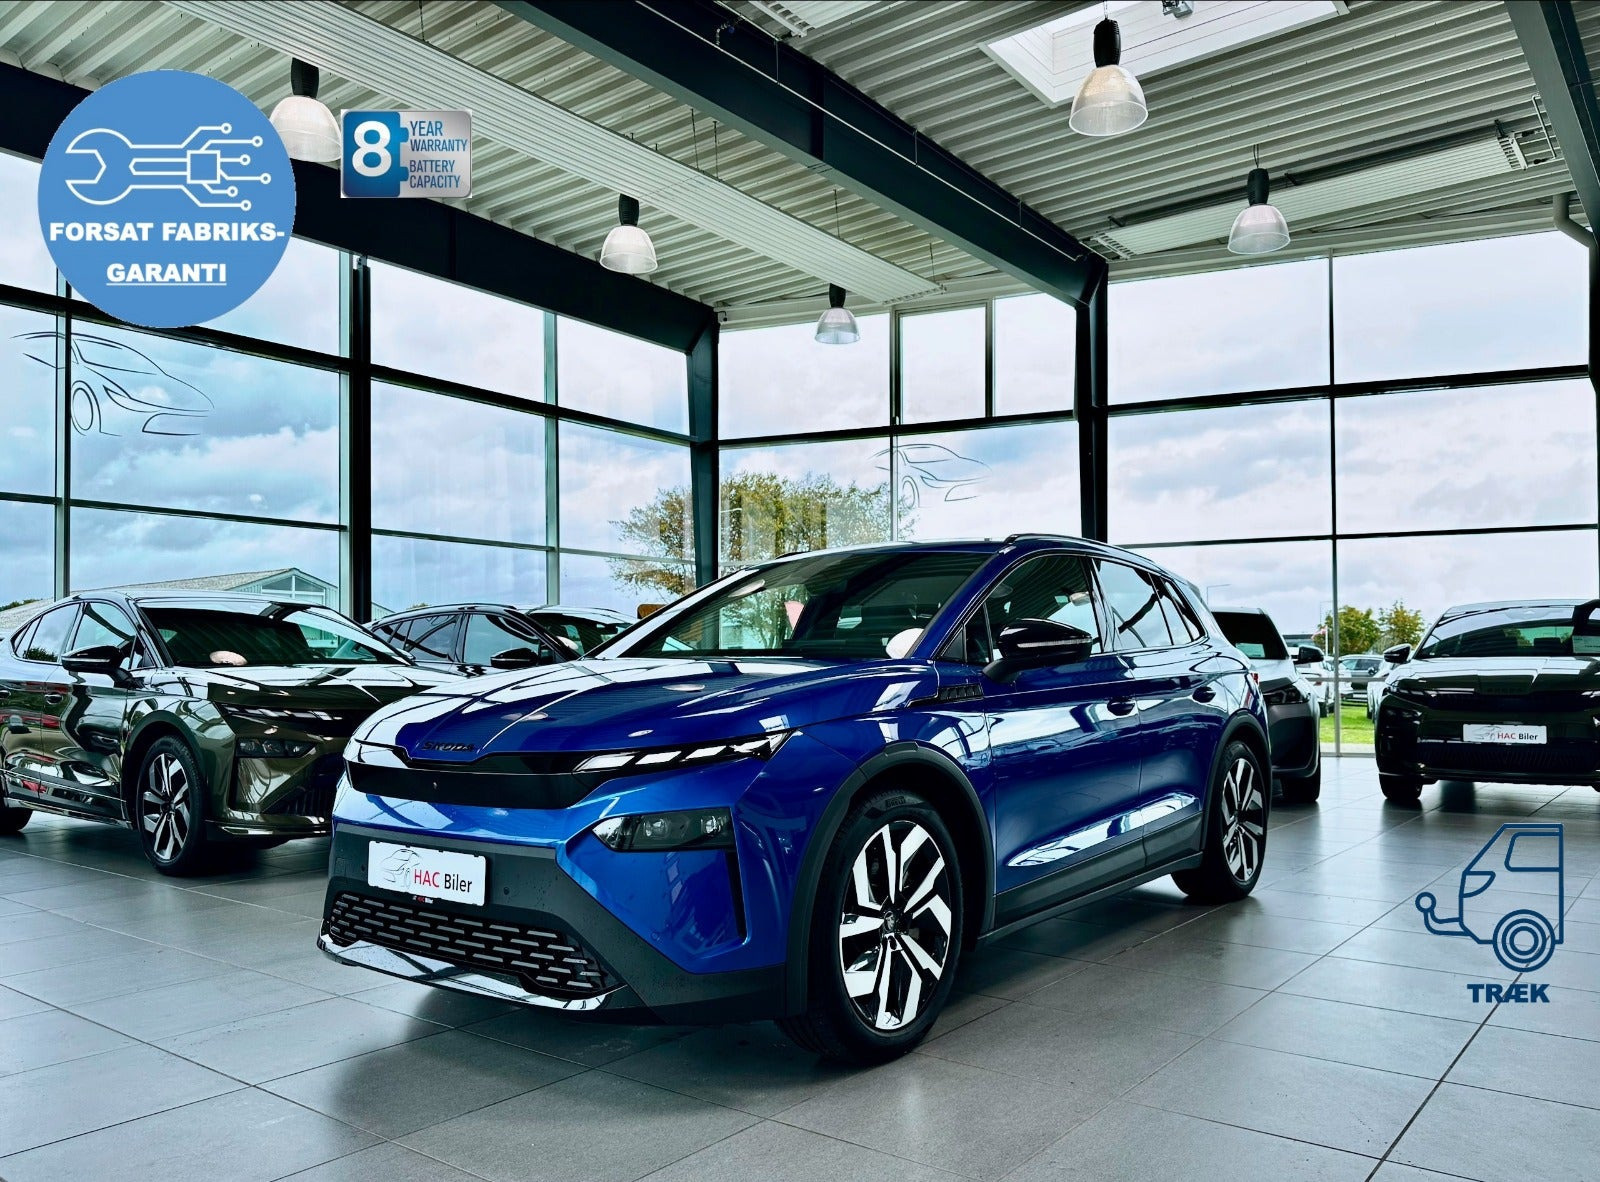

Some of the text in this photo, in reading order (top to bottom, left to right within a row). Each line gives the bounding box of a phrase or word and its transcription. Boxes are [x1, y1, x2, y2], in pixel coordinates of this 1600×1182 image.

[1497, 732, 1539, 741] HAC Biler
[414, 868, 473, 893] HAC Biler
